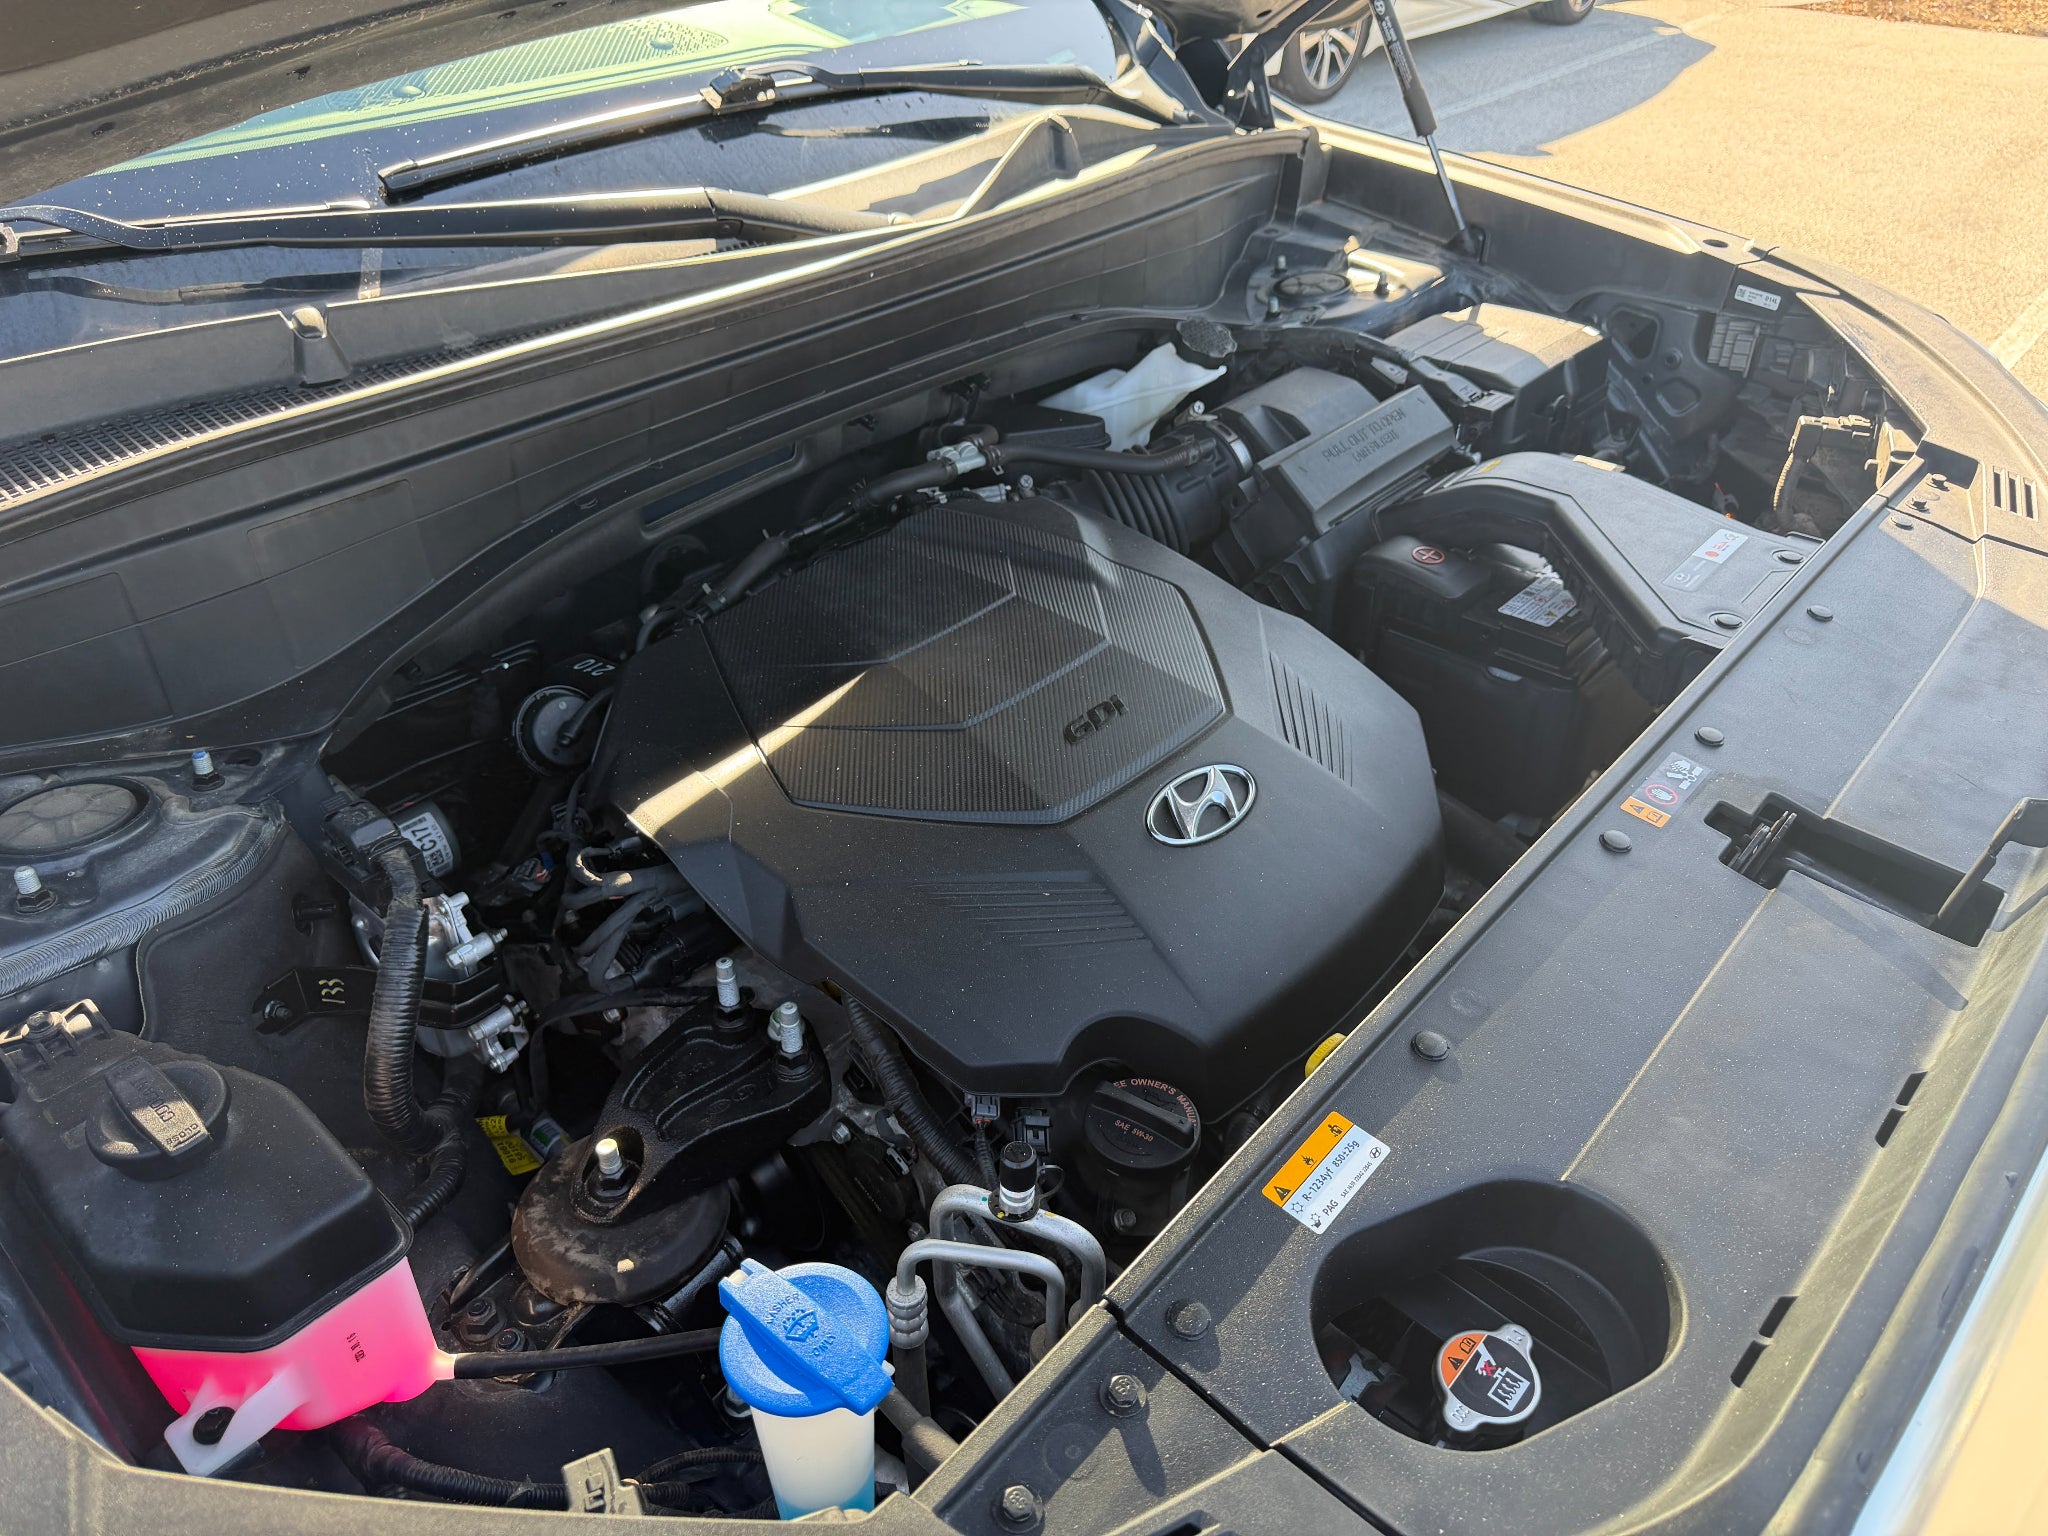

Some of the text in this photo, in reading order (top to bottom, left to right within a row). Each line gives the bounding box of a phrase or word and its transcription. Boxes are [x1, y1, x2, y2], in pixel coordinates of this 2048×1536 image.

[1063, 694, 1128, 744] GDI
[411, 827, 437, 852] C17
[1130, 1078, 1177, 1095] OWNER'S
[166, 1122, 199, 1145] CLOSE
[1114, 1119, 1154, 1142] SAE 5W-30
[1301, 1139, 1360, 1202] R-1234yf 850±25g
[1322, 1199, 1339, 1216] PAG
[764, 1292, 800, 1325] WASHER
[811, 1333, 837, 1357] ONLY
